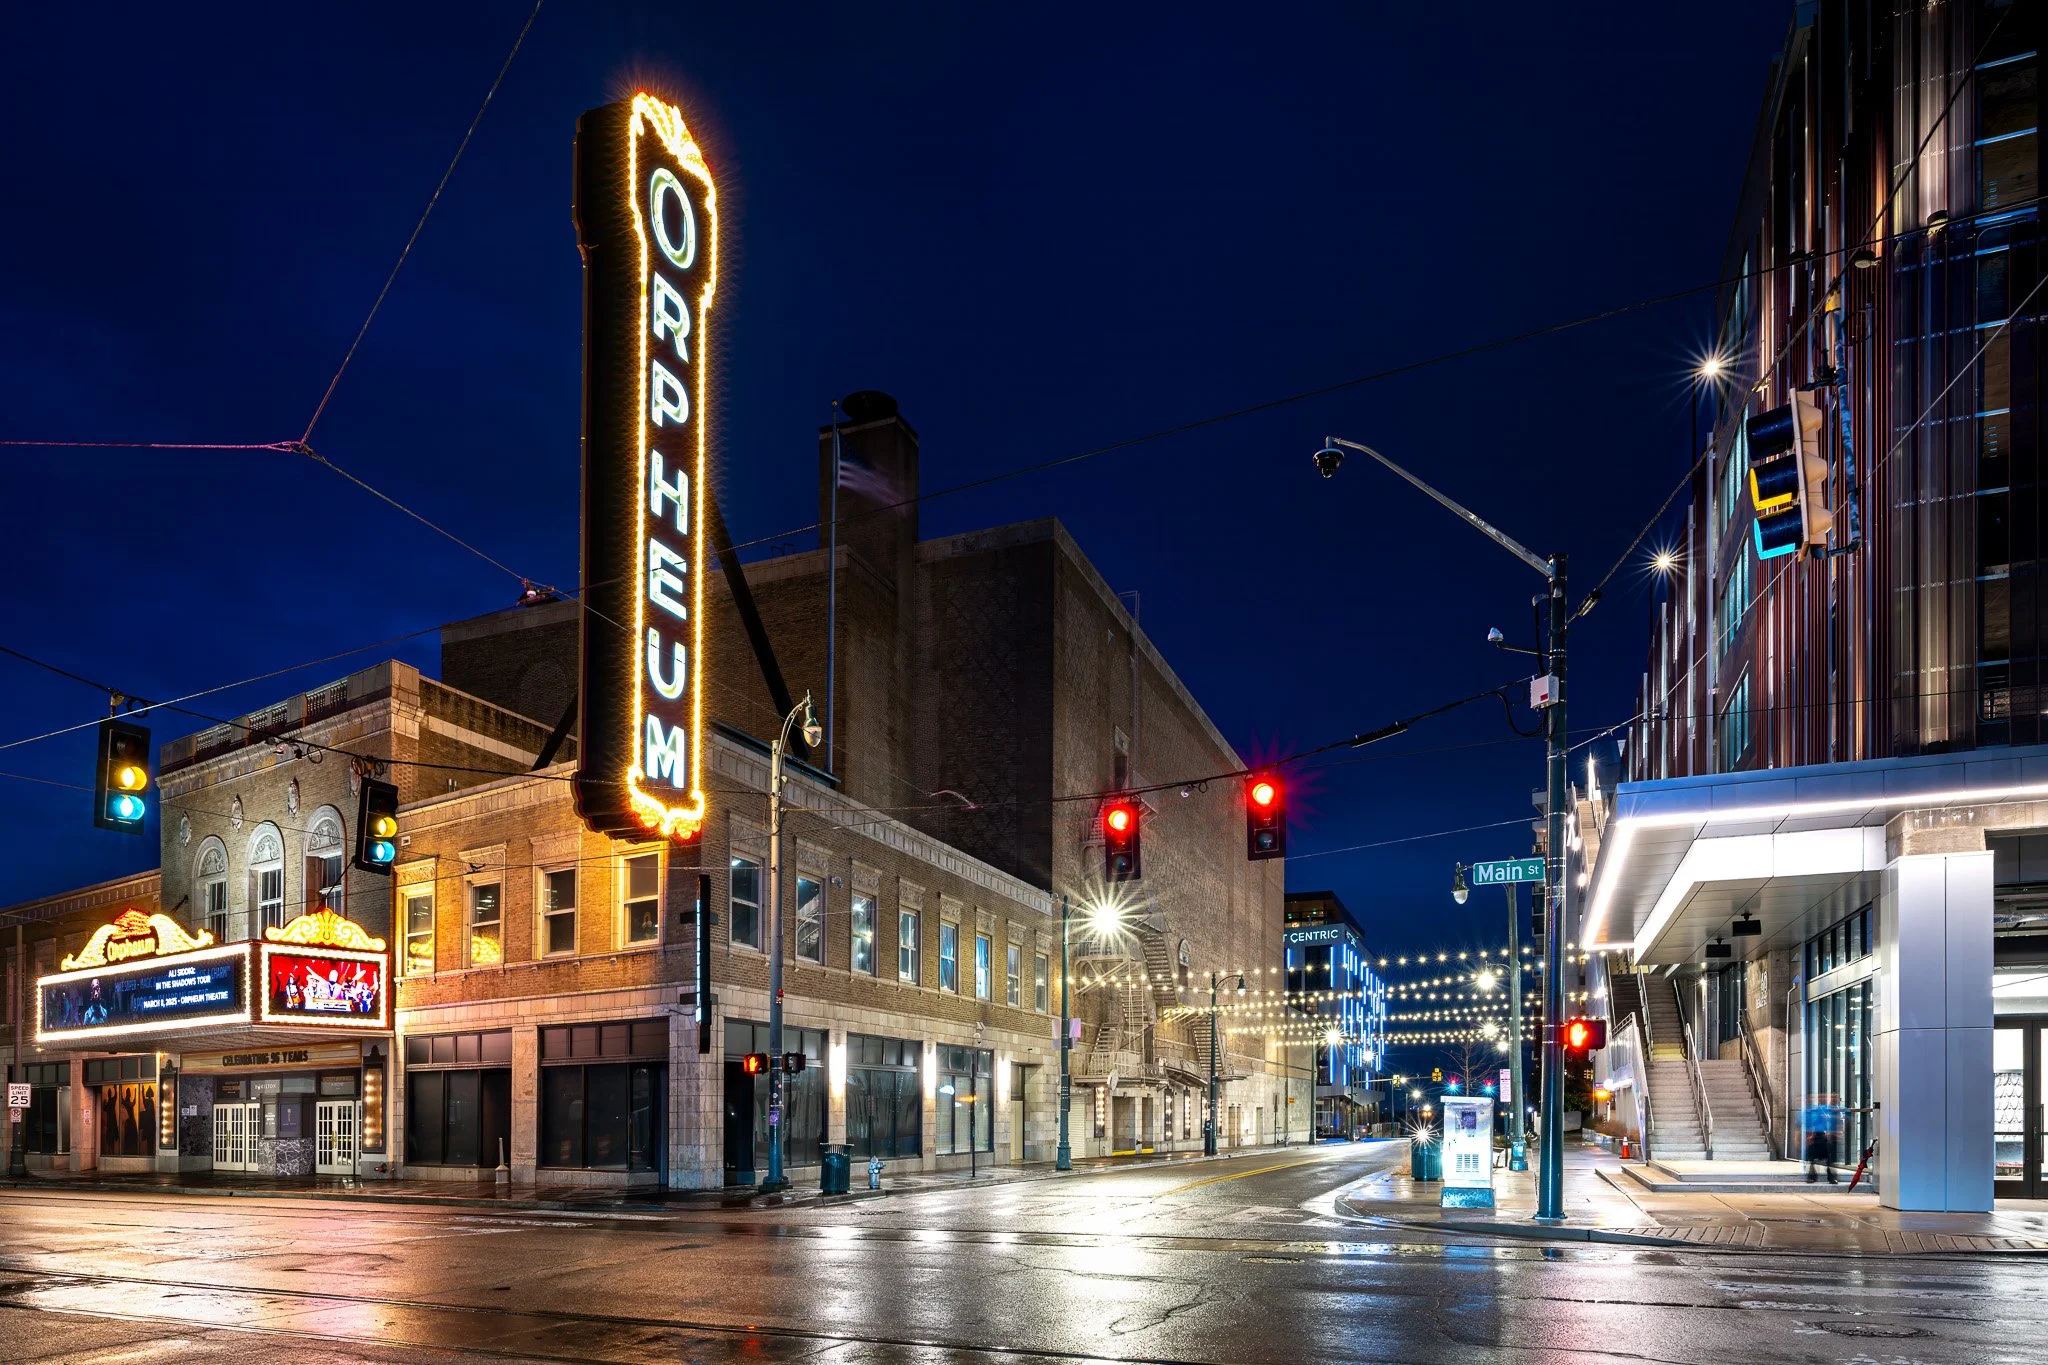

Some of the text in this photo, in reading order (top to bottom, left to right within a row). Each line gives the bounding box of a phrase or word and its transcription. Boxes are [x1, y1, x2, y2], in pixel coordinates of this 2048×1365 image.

[646, 167, 695, 789] ORPHEUM
[1478, 863, 1540, 882] Main St
[1290, 929, 1339, 943] CENTRIC
[107, 937, 155, 962] Orpheum
[168, 969, 176, 978] ALI
[155, 982, 161, 990] IN
[161, 981, 171, 989] THE
[171, 977, 197, 988] SHADOWS
[197, 975, 211, 984] TOUR
[143, 999, 160, 1009] MARCH
[165, 997, 177, 1007] 2025
[180, 994, 205, 1005] ORPHEUM
[204, 990, 229, 1001] THEATRE
[222, 1053, 269, 1067] CELEBRATING
[282, 1050, 309, 1063] YEARS
[10, 1095, 29, 1105] 25
